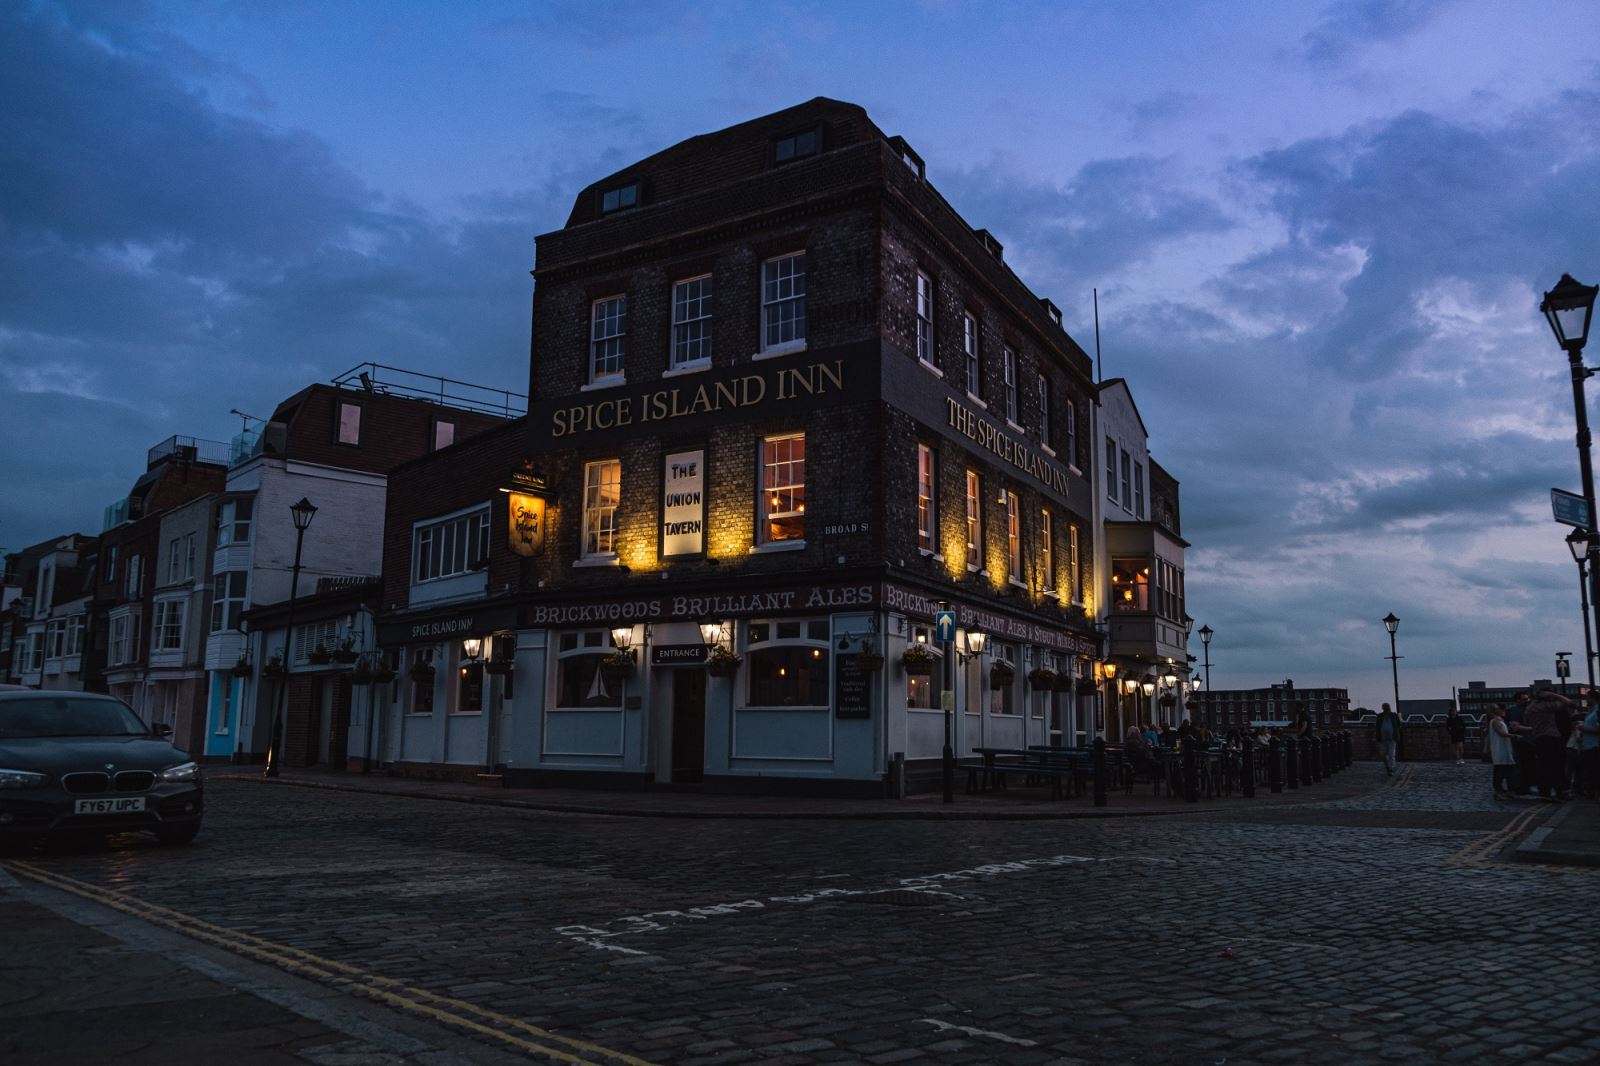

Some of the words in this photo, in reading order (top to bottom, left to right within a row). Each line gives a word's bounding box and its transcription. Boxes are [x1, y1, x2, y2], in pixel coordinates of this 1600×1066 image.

[551, 397, 633, 438] SPICE
[640, 374, 767, 422] ISLAND
[775, 359, 845, 400] INN
[946, 396, 977, 440] THE
[977, 418, 1013, 462] SPICE
[1013, 442, 1052, 486] ISLAND
[1053, 467, 1069, 497] INN
[671, 462, 697, 479] THE
[666, 491, 701, 508] UNION
[517, 506, 538, 520] Spice
[515, 518, 538, 535] Island
[664, 519, 701, 536] TAVERN
[825, 525, 857, 535] BROAD
[533, 601, 662, 624] BRICKWOODS
[671, 591, 795, 616] BRILLIANT
[804, 585, 873, 608] ALES
[412, 623, 431, 638] SPICE
[431, 619, 457, 635] ISLAND
[458, 617, 473, 631] INN
[1007, 618, 1027, 638] ALES
[659, 648, 700, 658] ENTRANCE
[80, 801, 113, 812] FY67
[116, 799, 139, 810] UPC
